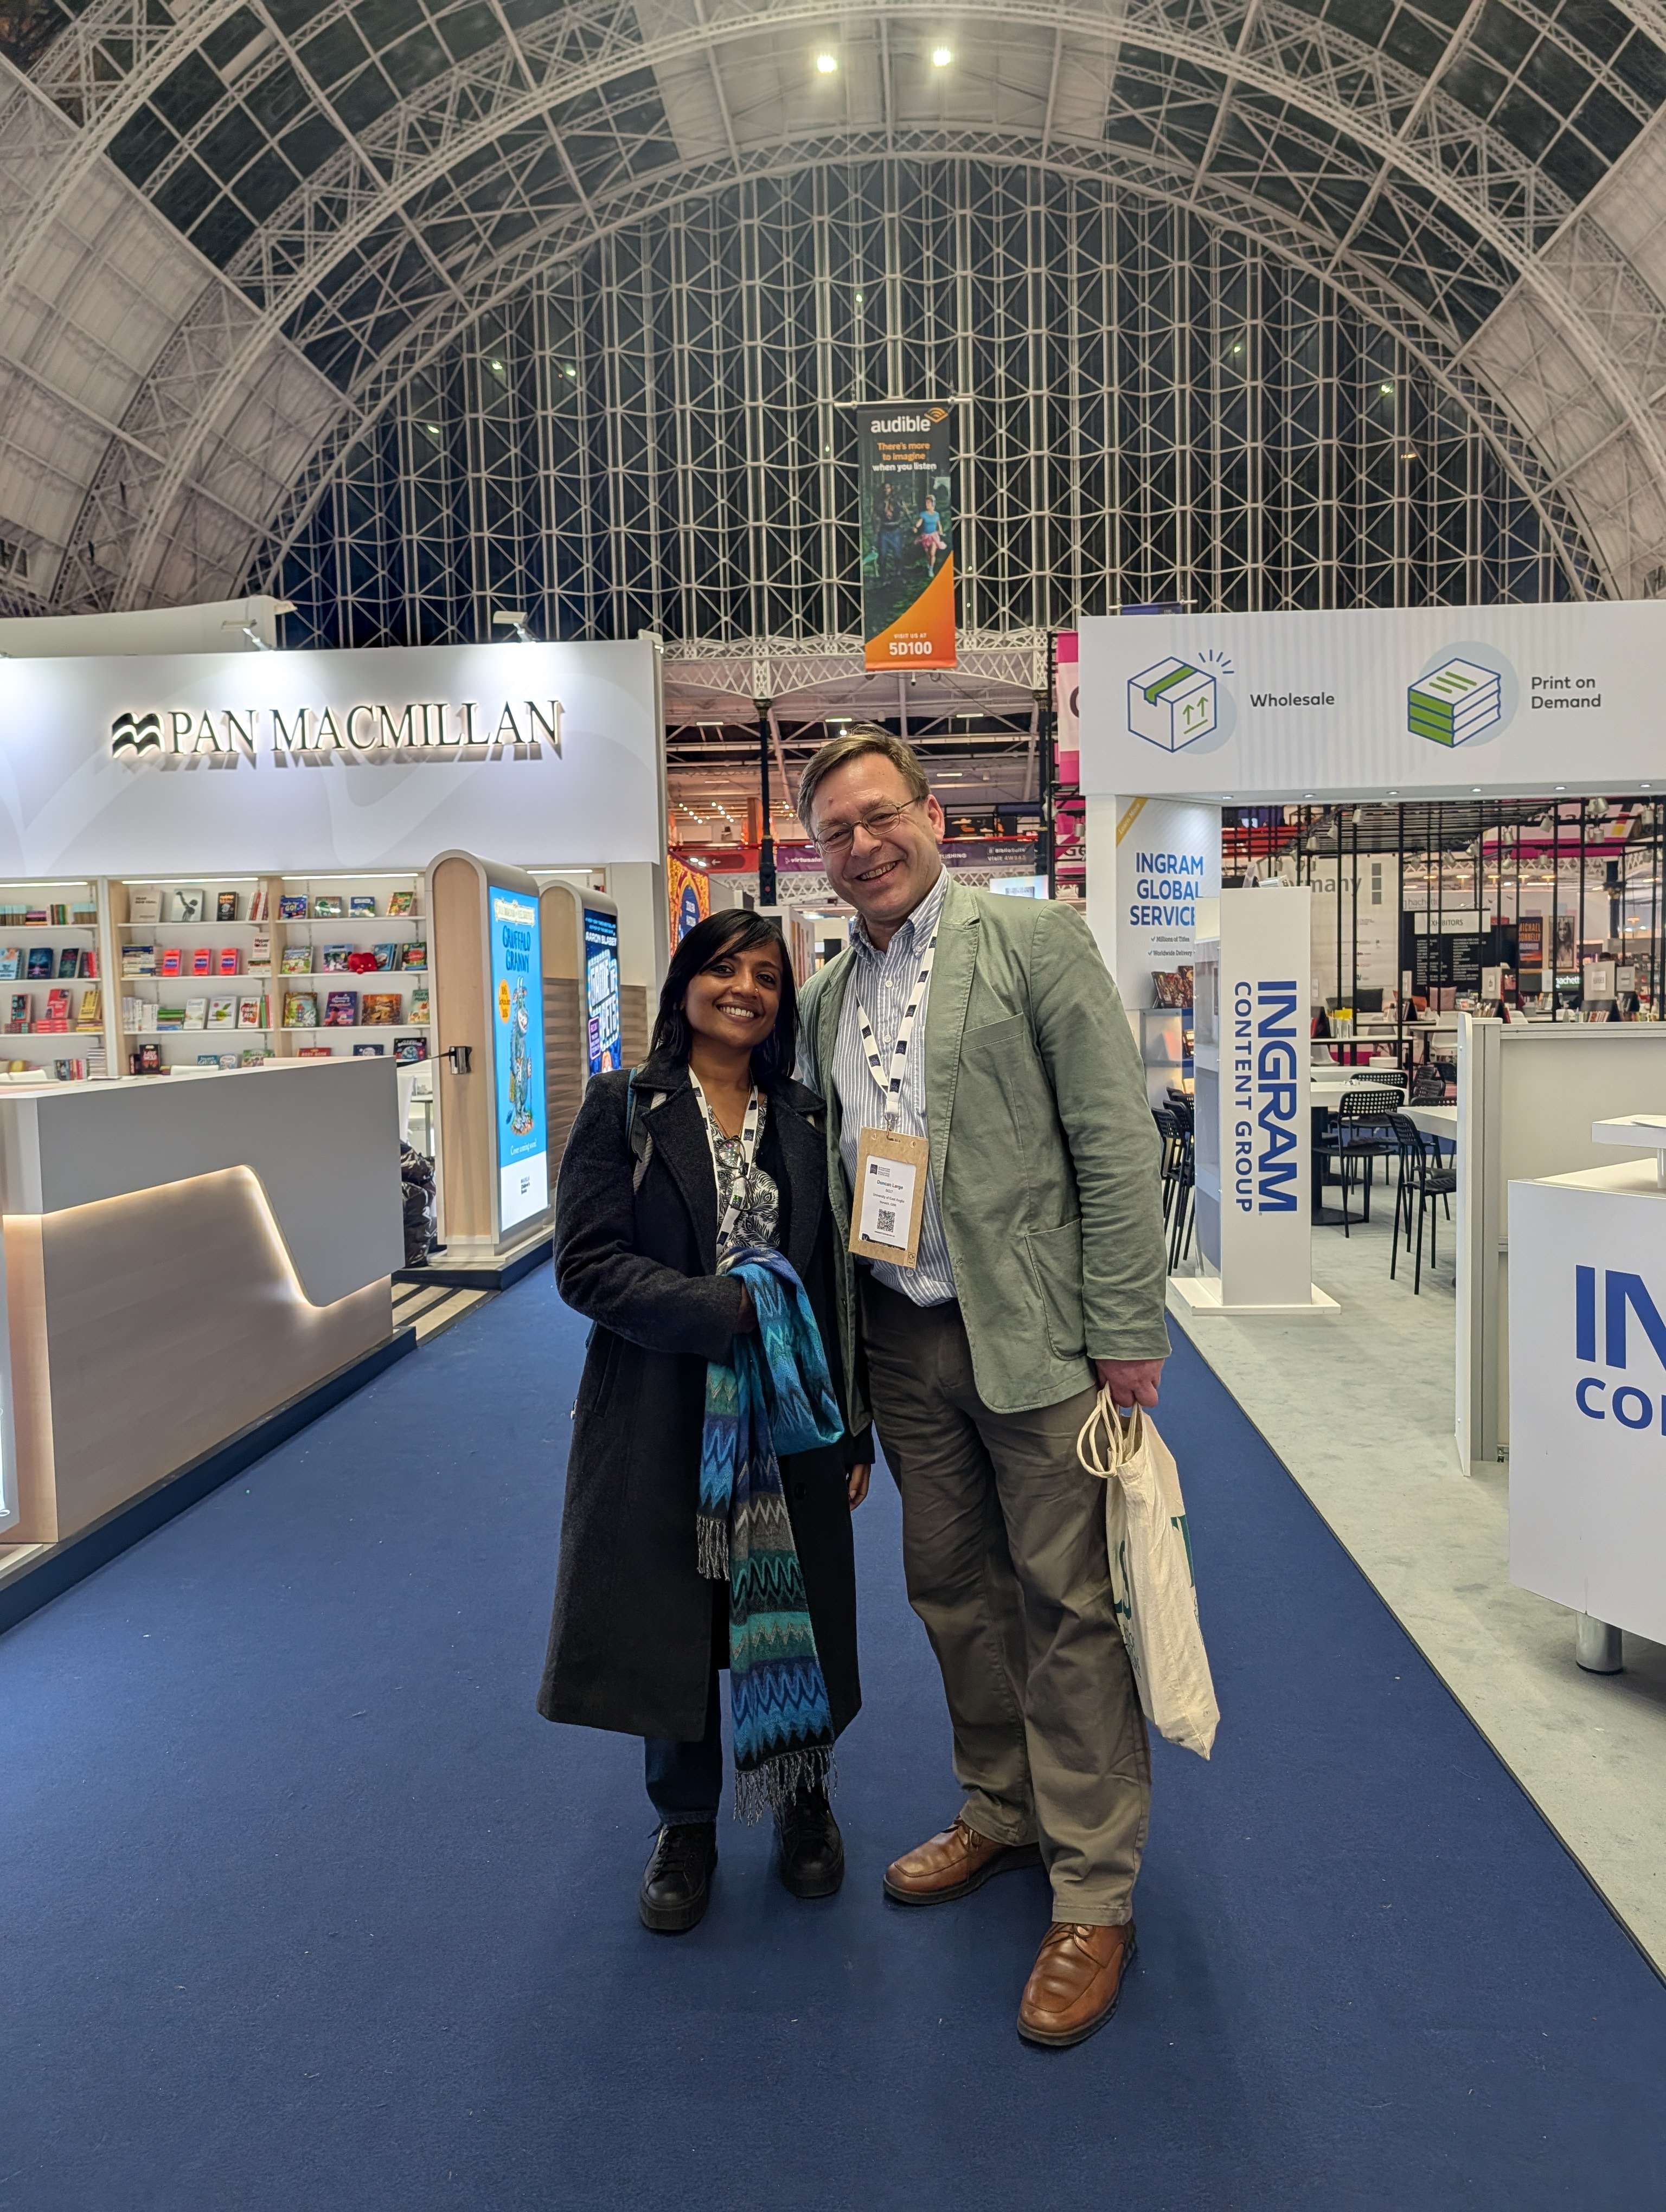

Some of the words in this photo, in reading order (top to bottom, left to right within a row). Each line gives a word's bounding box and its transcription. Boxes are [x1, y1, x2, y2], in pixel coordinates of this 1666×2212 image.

[870, 415, 931, 433] audible
[877, 442, 907, 451] There's
[893, 452, 926, 461] imagine
[872, 463, 896, 471] when
[897, 464, 913, 472] you
[914, 462, 937, 471] listen
[889, 641, 933, 655] 5D100
[1532, 676, 1571, 690] Print
[1575, 678, 1595, 689] on
[1250, 691, 1335, 707] Wholesale
[1532, 693, 1601, 709] Demand
[168, 708, 258, 755] PAN
[270, 700, 560, 751] MACMILLAN
[1136, 852, 1204, 876] INGRAM
[1137, 879, 1199, 900] GLOBAL
[1130, 905, 1195, 926] SERVIC
[502, 925, 531, 951] GRUFFALO
[505, 950, 530, 973] GRANNY
[1234, 981, 1252, 1110] CONTENT
[1258, 981, 1297, 1212] INGRAM
[1235, 1121, 1253, 1212] GROUP
[1575, 1377, 1666, 1437] CO
